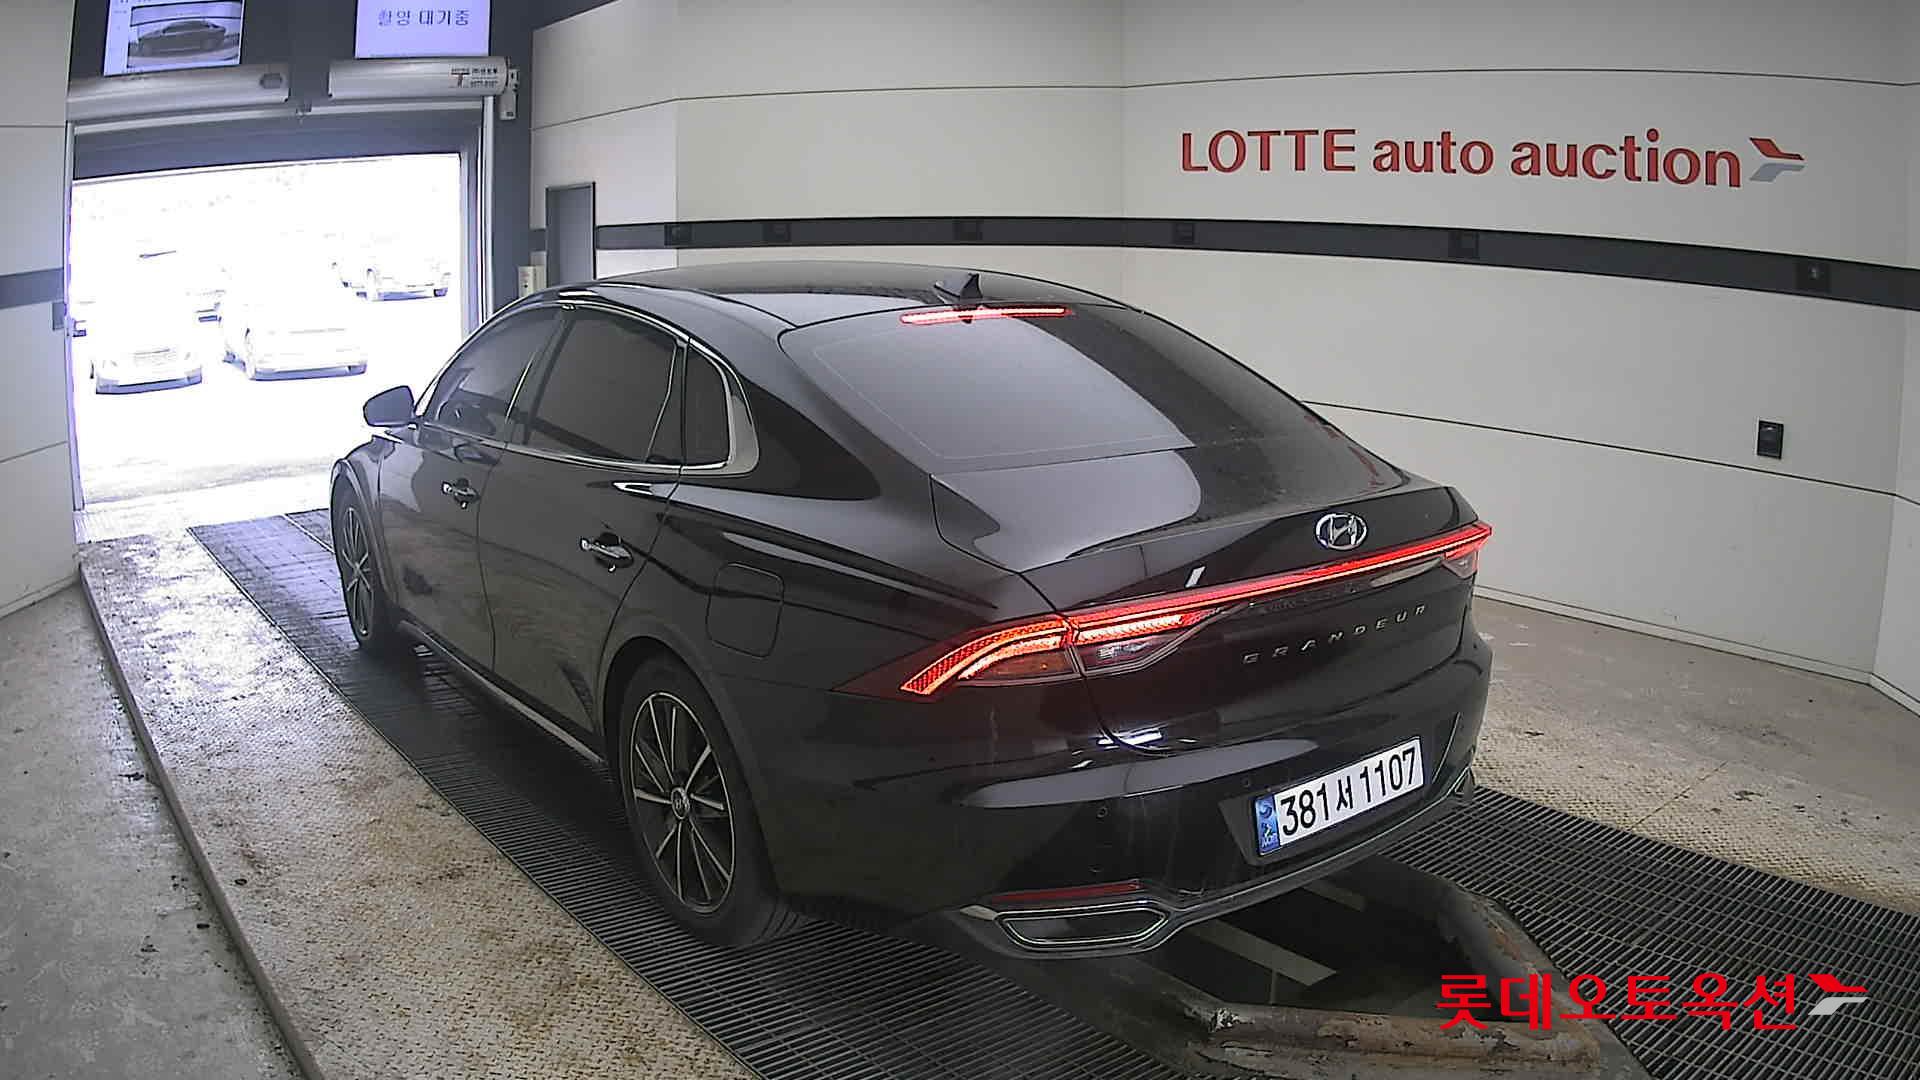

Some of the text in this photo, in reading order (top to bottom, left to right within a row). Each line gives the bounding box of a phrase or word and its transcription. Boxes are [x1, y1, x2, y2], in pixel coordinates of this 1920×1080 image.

[419, 9, 470, 26] 대기중
[1181, 128, 1741, 188] LOTTE auto auction
[1243, 604, 1426, 664] GRANDEUR
[1280, 746, 1416, 836] 381서 1107
